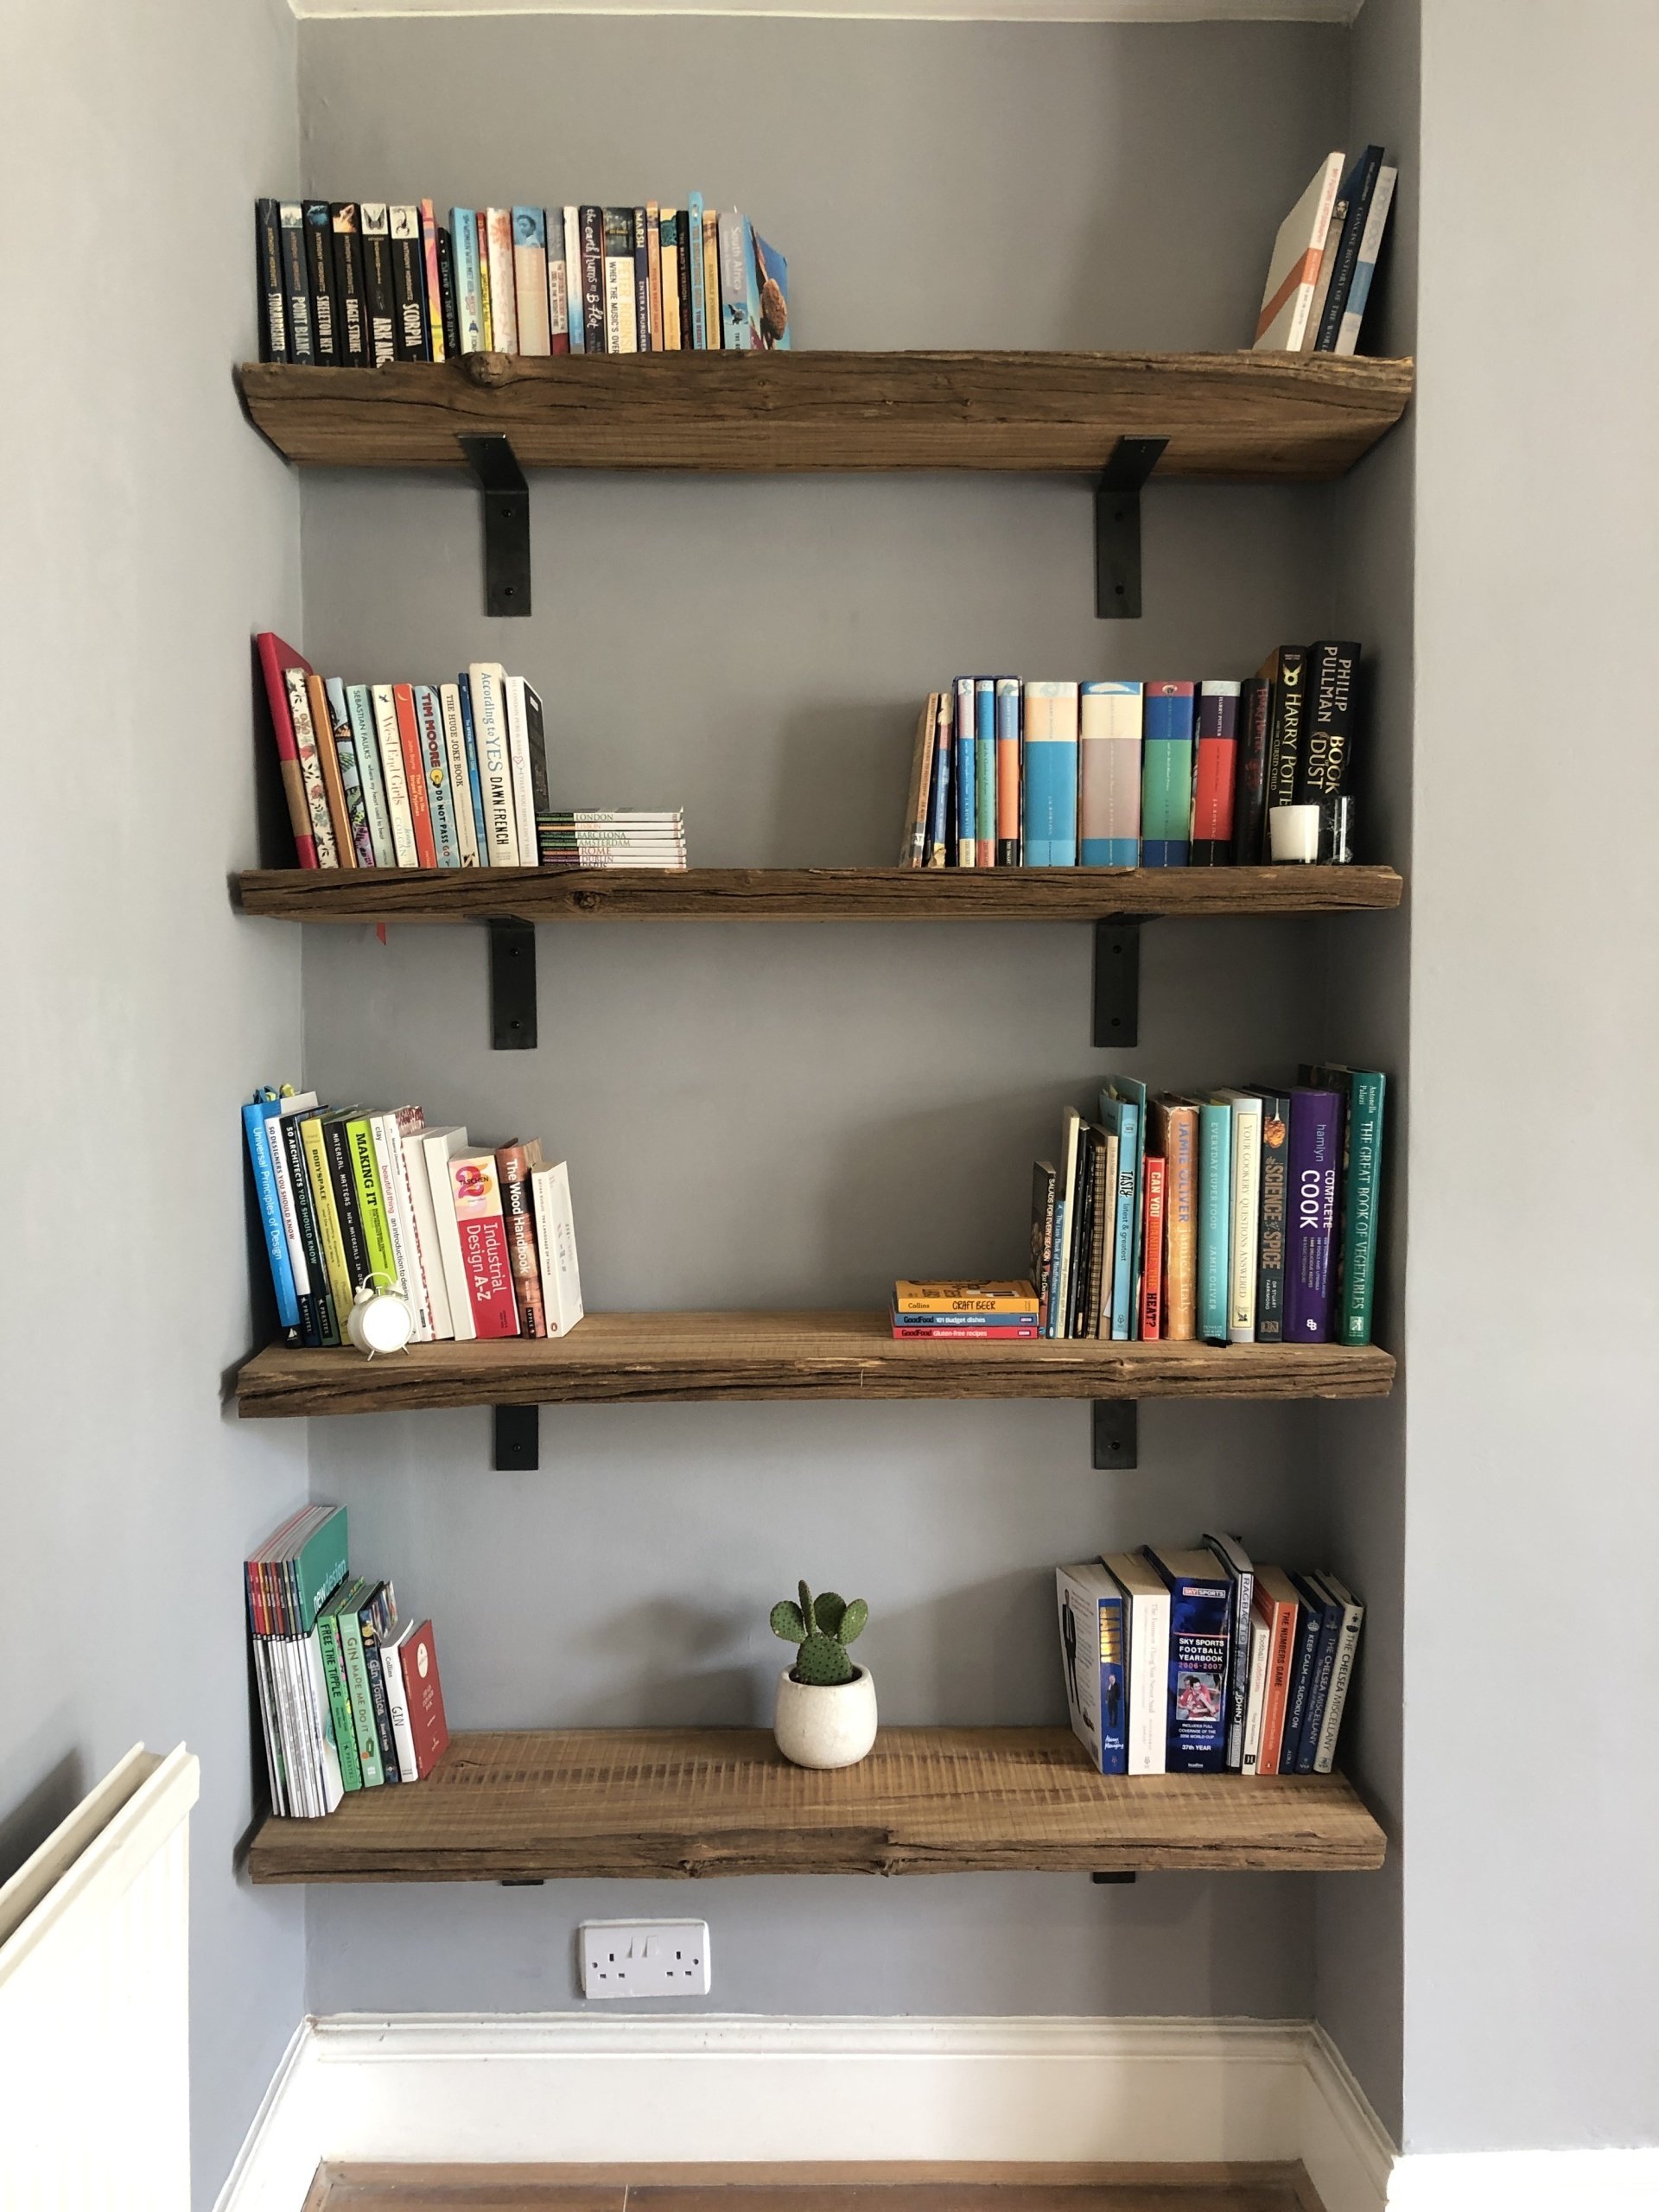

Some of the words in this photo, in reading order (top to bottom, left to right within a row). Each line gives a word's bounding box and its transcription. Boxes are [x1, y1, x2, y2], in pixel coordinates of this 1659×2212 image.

[731, 227, 741, 257] South
[733, 260, 743, 289] Africa
[269, 293, 284, 351] STORMBREAKER
[292, 296, 308, 325] POINT
[316, 296, 331, 335] SKELETON
[346, 299, 358, 323] EAGLE
[403, 304, 422, 346] SCORPIA
[296, 327, 309, 355] BLANC
[348, 325, 361, 353] STRIKE
[372, 318, 392, 340] ARK
[320, 338, 333, 353] KEY
[375, 342, 393, 368] ANG
[481, 672, 495, 725] According
[1318, 646, 1338, 722] PULLMAN
[1335, 659, 1351, 712] PHILIP
[422, 693, 433, 717] TIM
[446, 695, 454, 712] THE
[353, 690, 365, 731] SEBASTIAN
[359, 733, 371, 760] FAULKS
[486, 728, 496, 736] to
[1282, 693, 1301, 750] HARRY
[425, 720, 441, 767] MOORE
[451, 740, 460, 761] JOKE
[486, 737, 503, 772] YES
[454, 764, 463, 787] BOOK
[1306, 739, 1325, 790] DUST
[1325, 736, 1344, 794] BOOK
[490, 777, 504, 805] DAWN
[1279, 756, 1296, 806] POTTE
[371, 791, 379, 806] heart
[374, 808, 383, 819] used
[435, 791, 442, 801] DO
[442, 845, 449, 856] GO
[493, 809, 509, 845] FRENCH
[1358, 1085, 1367, 1105] Palazzi
[1368, 1085, 1376, 1113] Antonella
[286, 1127, 294, 1137] 50
[374, 1127, 384, 1141] clay
[1179, 1122, 1190, 1165] JAMIE
[1210, 1122, 1218, 1170] EVERYDAY
[1243, 1125, 1253, 1150] YOUR
[1315, 1124, 1326, 1162] hamlyn
[1360, 1121, 1374, 1143] THE
[252, 1127, 270, 1168] Universal
[270, 1135, 283, 1173] DESIGNERS
[288, 1139, 303, 1187] ARCHITECTS
[312, 1149, 327, 1200] BODYSPACE
[333, 1133, 344, 1170] MATERIAL
[340, 1173, 351, 1206] MATTERS
[356, 1133, 373, 1189] MAKING
[366, 1192, 377, 1206] IT
[506, 1159, 519, 1181] The
[1241, 1154, 1252, 1195] COOKERY
[1357, 1147, 1372, 1184] GREAT
[259, 1170, 275, 1215] Principles
[460, 1176, 488, 1185] TASCHEN
[1120, 1171, 1134, 1197] TASTY
[1151, 1173, 1161, 1194] CAN
[1264, 1164, 1283, 1220] SCIENCE
[281, 1191, 290, 1217] SHOULD
[297, 1189, 306, 1205] YOU
[510, 1182, 523, 1215] Wood
[1150, 1197, 1160, 1217] YOU
[1179, 1169, 1190, 1223] OLIVER
[1300, 1170, 1319, 1229] COOK
[1323, 1170, 1334, 1229] COMPLETE
[1356, 1187, 1369, 1217] BOOK
[266, 1217, 276, 1227] of
[285, 1218, 295, 1240] KNOW
[301, 1208, 312, 1238] SHOULD
[1239, 1198, 1249, 1249] QUESTIONS
[1356, 1222, 1368, 1237] OF
[269, 1230, 283, 1260] Design
[307, 1241, 317, 1264] KNOW
[467, 1225, 484, 1272] Design
[514, 1217, 530, 1273] Handbook
[1148, 1221, 1159, 1263] HANDLE
[1178, 1227, 1192, 1279] jamie's
[1262, 1231, 1281, 1269] SPICE
[483, 1223, 506, 1293] Industrial
[474, 1275, 492, 1301] A-Z
[1148, 1268, 1157, 1288] THE
[1239, 1250, 1248, 1298] ANSWERED
[1351, 1242, 1367, 1309] VEGETABLES
[952, 1301, 975, 1310] CRAFT
[976, 1301, 995, 1310] BEER
[1146, 1293, 1157, 1327] HEAT?
[1179, 1283, 1192, 1313] italy
[302, 1305, 312, 1332] PRESTEL
[320, 1306, 328, 1334] PRESTEL
[526, 1308, 535, 1328] APPLE
[321, 1624, 331, 1646] FREE
[346, 1637, 359, 1661] GIN
[1277, 1627, 1287, 1663] NUMBERS
[1326, 1637, 1336, 1654] THE
[1344, 1635, 1355, 1650] THE
[325, 1649, 334, 1666] THE
[368, 1660, 382, 1676] Gin
[327, 1668, 341, 1698] TIPPLE
[352, 1664, 363, 1690] MADE
[1319, 1656, 1332, 1691] CHELSEA
[1336, 1655, 1350, 1692] CHELSEA
[358, 1694, 365, 1707] ME
[374, 1680, 385, 1715] Tonica
[359, 1709, 366, 1722] DO
[391, 1707, 404, 1726] GIN
[1310, 1693, 1325, 1745] MISCELLANY
[1324, 1694, 1341, 1751] MISCELLANY
